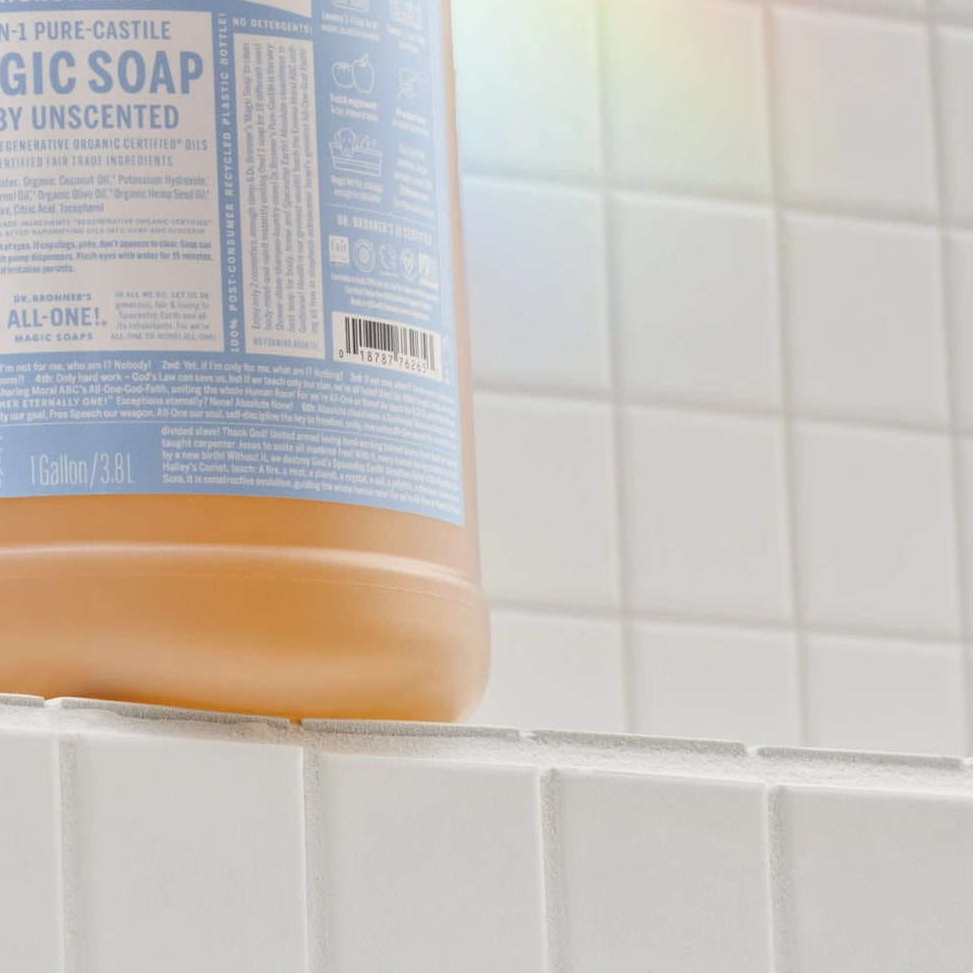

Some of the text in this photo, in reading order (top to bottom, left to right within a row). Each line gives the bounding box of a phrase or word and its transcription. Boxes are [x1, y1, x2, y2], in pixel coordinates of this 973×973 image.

[233, 17, 246, 26] NO
[35, 20, 171, 40] PURE-CASTILE
[88, 49, 204, 95] SOAP
[31, 104, 179, 129] UNSCENTED
[73, 138, 120, 149] ORGANIC
[185, 139, 208, 151] OILS
[47, 156, 68, 166] FAIR
[72, 156, 102, 166] TRADE
[106, 155, 173, 166] INGREDIENTS
[23, 176, 56, 187] Organic
[59, 175, 94, 185] Coconut
[119, 175, 162, 185] Potassium
[218, 13, 239, 353] 100% POST-CONSUMER RECYCLED PLASTIC BOTTLE!
[38, 190, 70, 201] Organic
[72, 189, 93, 199] Olive
[115, 189, 147, 200] Organic
[148, 189, 172, 199] Hemp
[174, 189, 194, 199] Seed
[60, 203, 104, 214] Tocopherol
[14, 295, 31, 303] DR.
[14, 333, 93, 343] MAGIC SOAPS
[16, 363, 30, 372] not
[34, 362, 46, 371] for
[67, 361, 85, 370] who
[114, 360, 151, 370] Nobody!
[339, 349, 427, 373] 0 18787 76265
[22, 397, 78, 407] ETERNALLY
